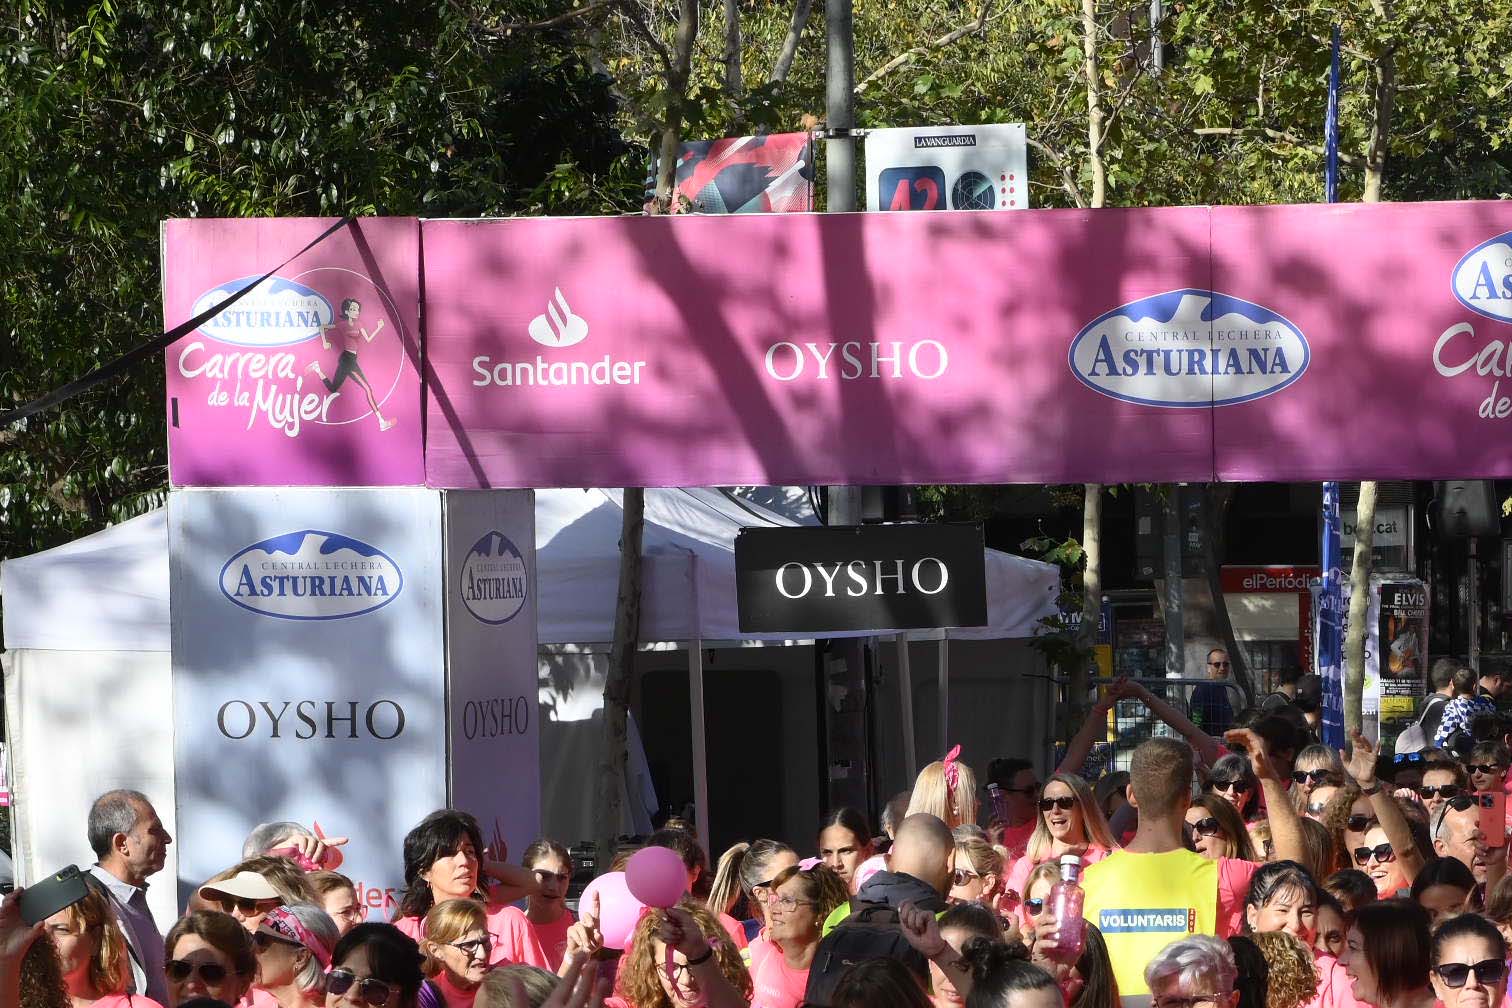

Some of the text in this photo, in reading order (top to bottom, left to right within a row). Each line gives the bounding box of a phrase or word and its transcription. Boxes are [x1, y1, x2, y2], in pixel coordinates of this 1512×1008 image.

[1125, 328, 1283, 343] CENTRAL LECHERA
[178, 341, 296, 380] Carrera
[472, 355, 646, 387] Santander
[764, 339, 948, 381] OYSHO
[1087, 334, 1291, 378] ASTURIANA
[207, 375, 341, 437] de la Mujer
[1478, 381, 1512, 419] de
[234, 562, 389, 598] ASTURIANA
[261, 561, 384, 571] CENTRAL LECHERA
[467, 565, 524, 602] ASTURIANA
[774, 557, 949, 599] OYSHO
[1394, 593, 1425, 605] ELVIS
[217, 700, 406, 740] OYSHO
[464, 695, 529, 741] OYSHO
[1100, 915, 1185, 928] VOLUNTARIS
